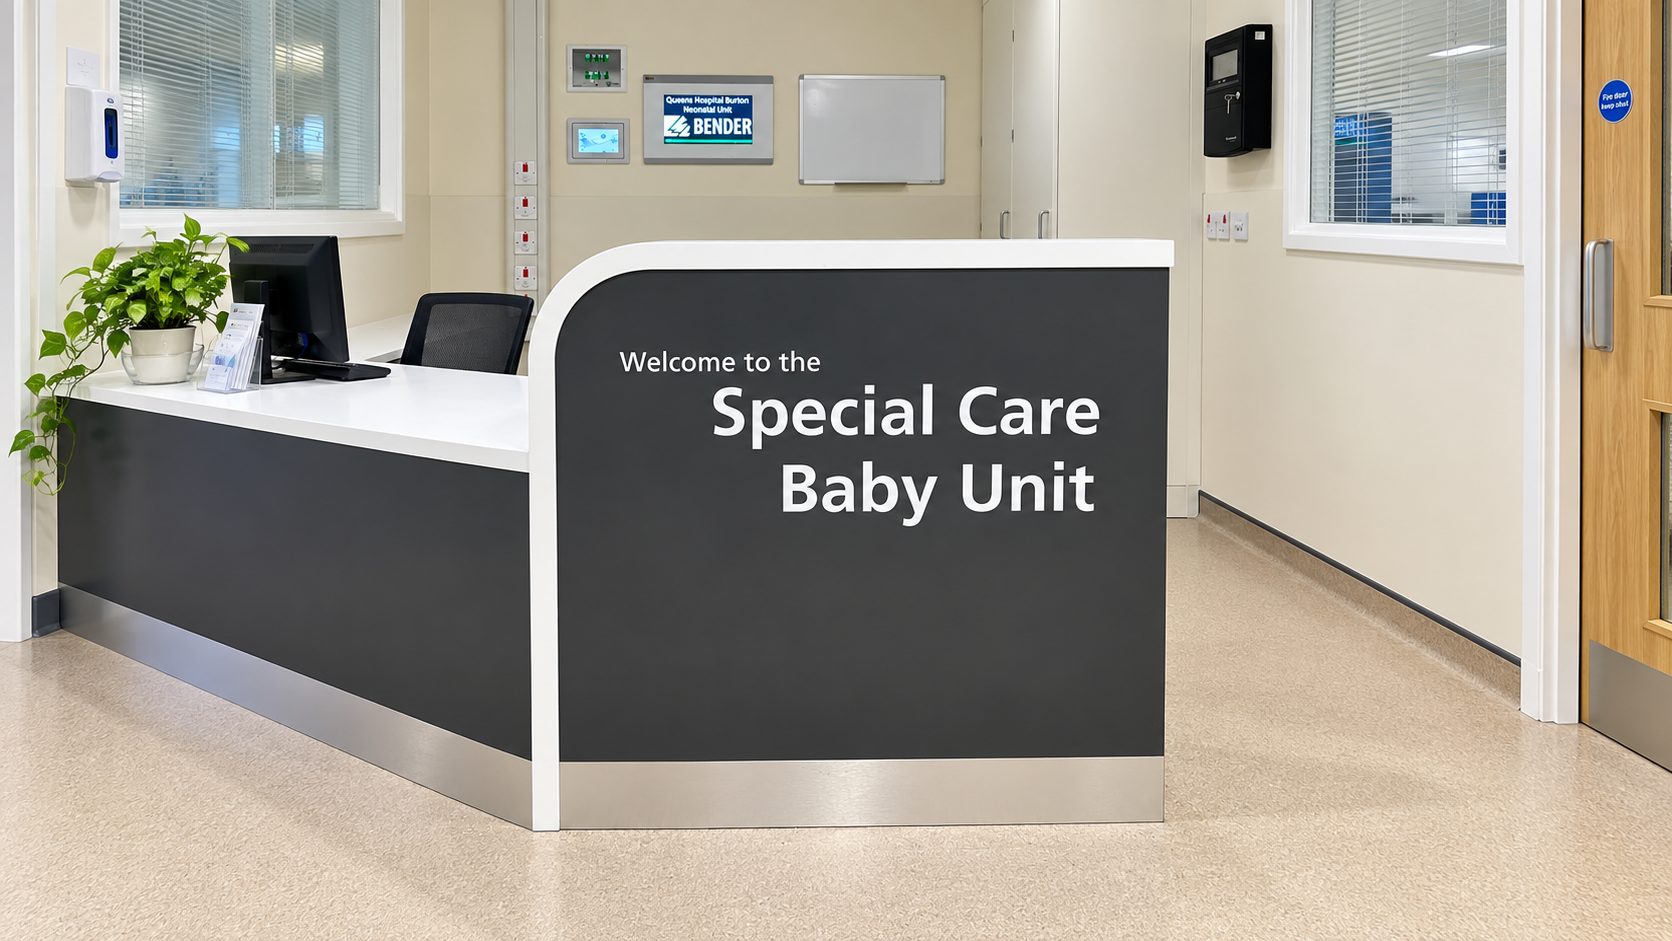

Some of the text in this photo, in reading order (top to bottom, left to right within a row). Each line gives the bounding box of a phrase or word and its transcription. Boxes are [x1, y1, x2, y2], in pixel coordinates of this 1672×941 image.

[693, 117, 752, 135] BENDER
[620, 350, 821, 373] Welcome to the
[712, 383, 1101, 450] Special Care
[782, 460, 1096, 527] Baby Unit
